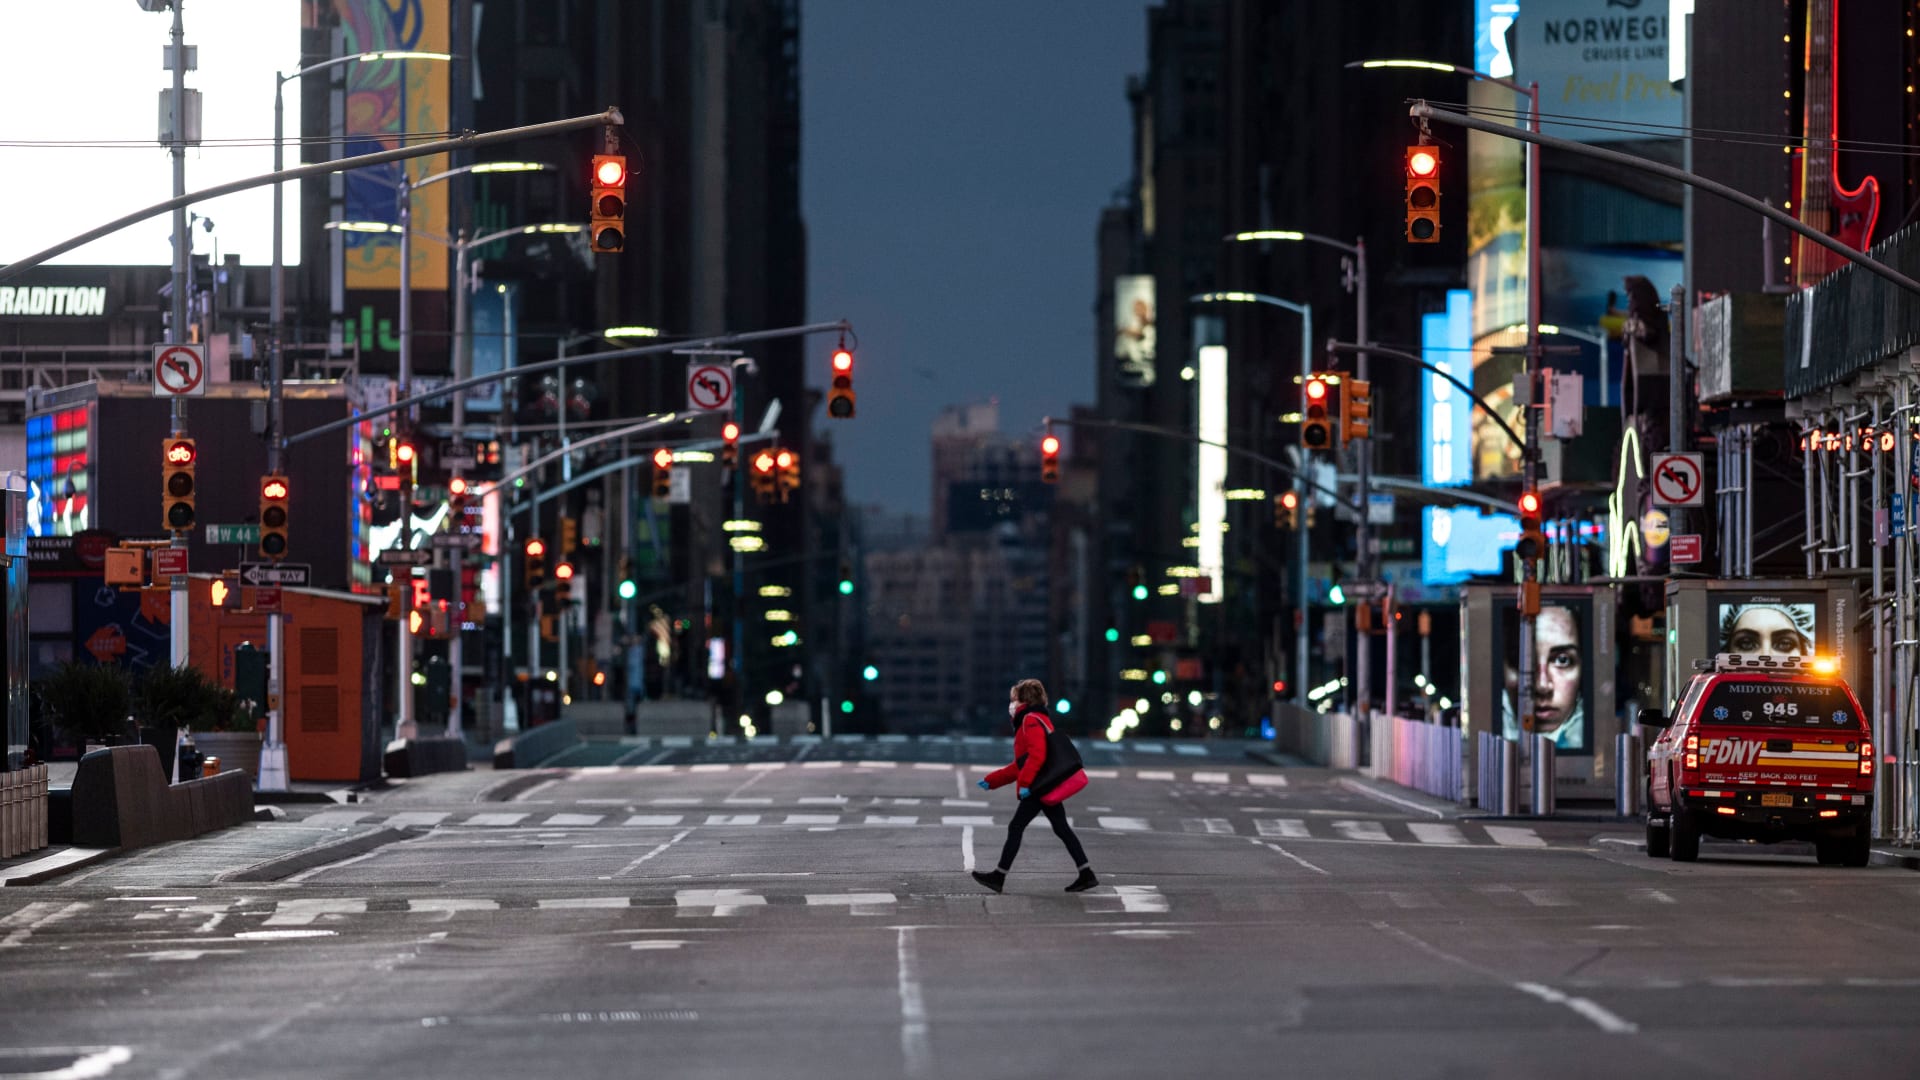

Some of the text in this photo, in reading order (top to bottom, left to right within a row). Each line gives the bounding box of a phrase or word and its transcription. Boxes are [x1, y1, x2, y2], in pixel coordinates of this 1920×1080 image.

[1544, 16, 1667, 45] NORWEGI
[1582, 45, 1665, 62] CRUISE LINE
[1562, 70, 1621, 104] Feel
[0, 286, 106, 316] RADITION
[220, 527, 232, 541] W
[236, 527, 251, 541] 44
[250, 569, 301, 580] ONE WAY
[1836, 599, 1845, 658] Newsstand
[1729, 684, 1832, 696] MIDTOWN WEST
[1763, 702, 1798, 716] 945
[1704, 739, 1763, 766] FDNY
